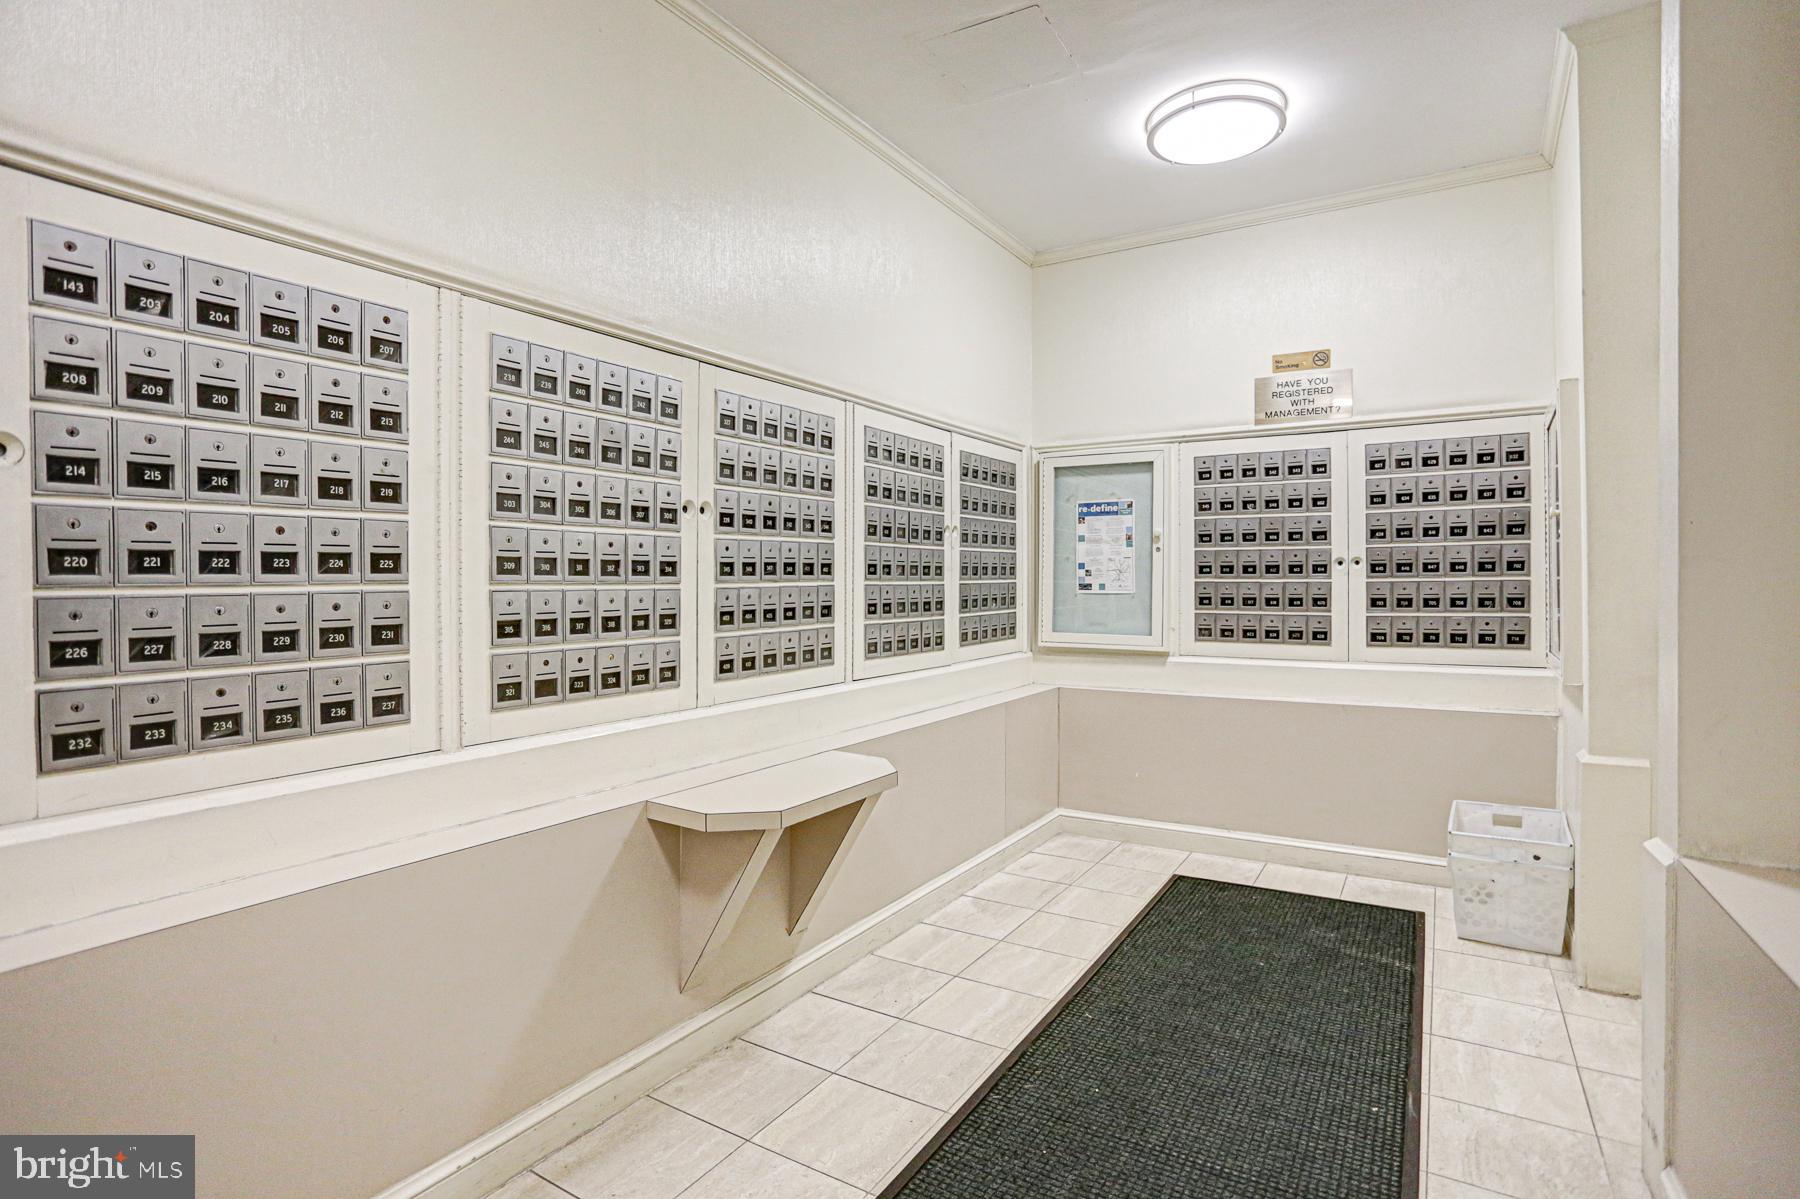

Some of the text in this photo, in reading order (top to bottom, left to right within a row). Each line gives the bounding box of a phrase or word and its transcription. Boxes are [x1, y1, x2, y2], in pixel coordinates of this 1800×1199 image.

[63, 279, 84, 293] 143
[140, 297, 162, 312] 203
[209, 311, 230, 323] 204
[272, 324, 291, 336] 205
[327, 334, 344, 346] 206
[379, 344, 394, 355] 207
[62, 372, 87, 385] 208
[503, 373, 516, 382] 238
[540, 380, 552, 389] 239
[1277, 380, 1302, 388] HAVE
[141, 384, 163, 396] 209
[575, 388, 586, 396] 240
[1272, 387, 1333, 398] REGISTERED
[212, 394, 228, 405] 210
[636, 400, 646, 409] 242
[274, 402, 286, 412] 211
[330, 410, 344, 420] 212
[381, 417, 394, 426] 213
[539, 440, 550, 449] 245
[574, 446, 585, 454] 246
[65, 465, 86, 476] 214
[144, 470, 162, 481] 215
[211, 476, 228, 486] 216
[274, 478, 289, 488] 217
[330, 485, 344, 495] 218
[380, 488, 393, 497] 219
[64, 556, 88, 567] 220
[143, 557, 160, 567] 221
[211, 558, 230, 568] 222
[273, 558, 290, 568] 223
[328, 559, 344, 568] 224
[379, 560, 394, 568] 225
[381, 630, 394, 639] 231
[504, 626, 514, 634] 315
[273, 636, 290, 646] 229
[328, 633, 345, 642] 230
[144, 644, 164, 655] 227
[212, 640, 232, 650] 228
[65, 647, 88, 659] 226
[382, 701, 396, 710] 237
[331, 707, 347, 717] 236
[276, 714, 293, 724] 235
[213, 720, 233, 731] 234
[145, 728, 166, 740] 233
[68, 737, 92, 750] 232
